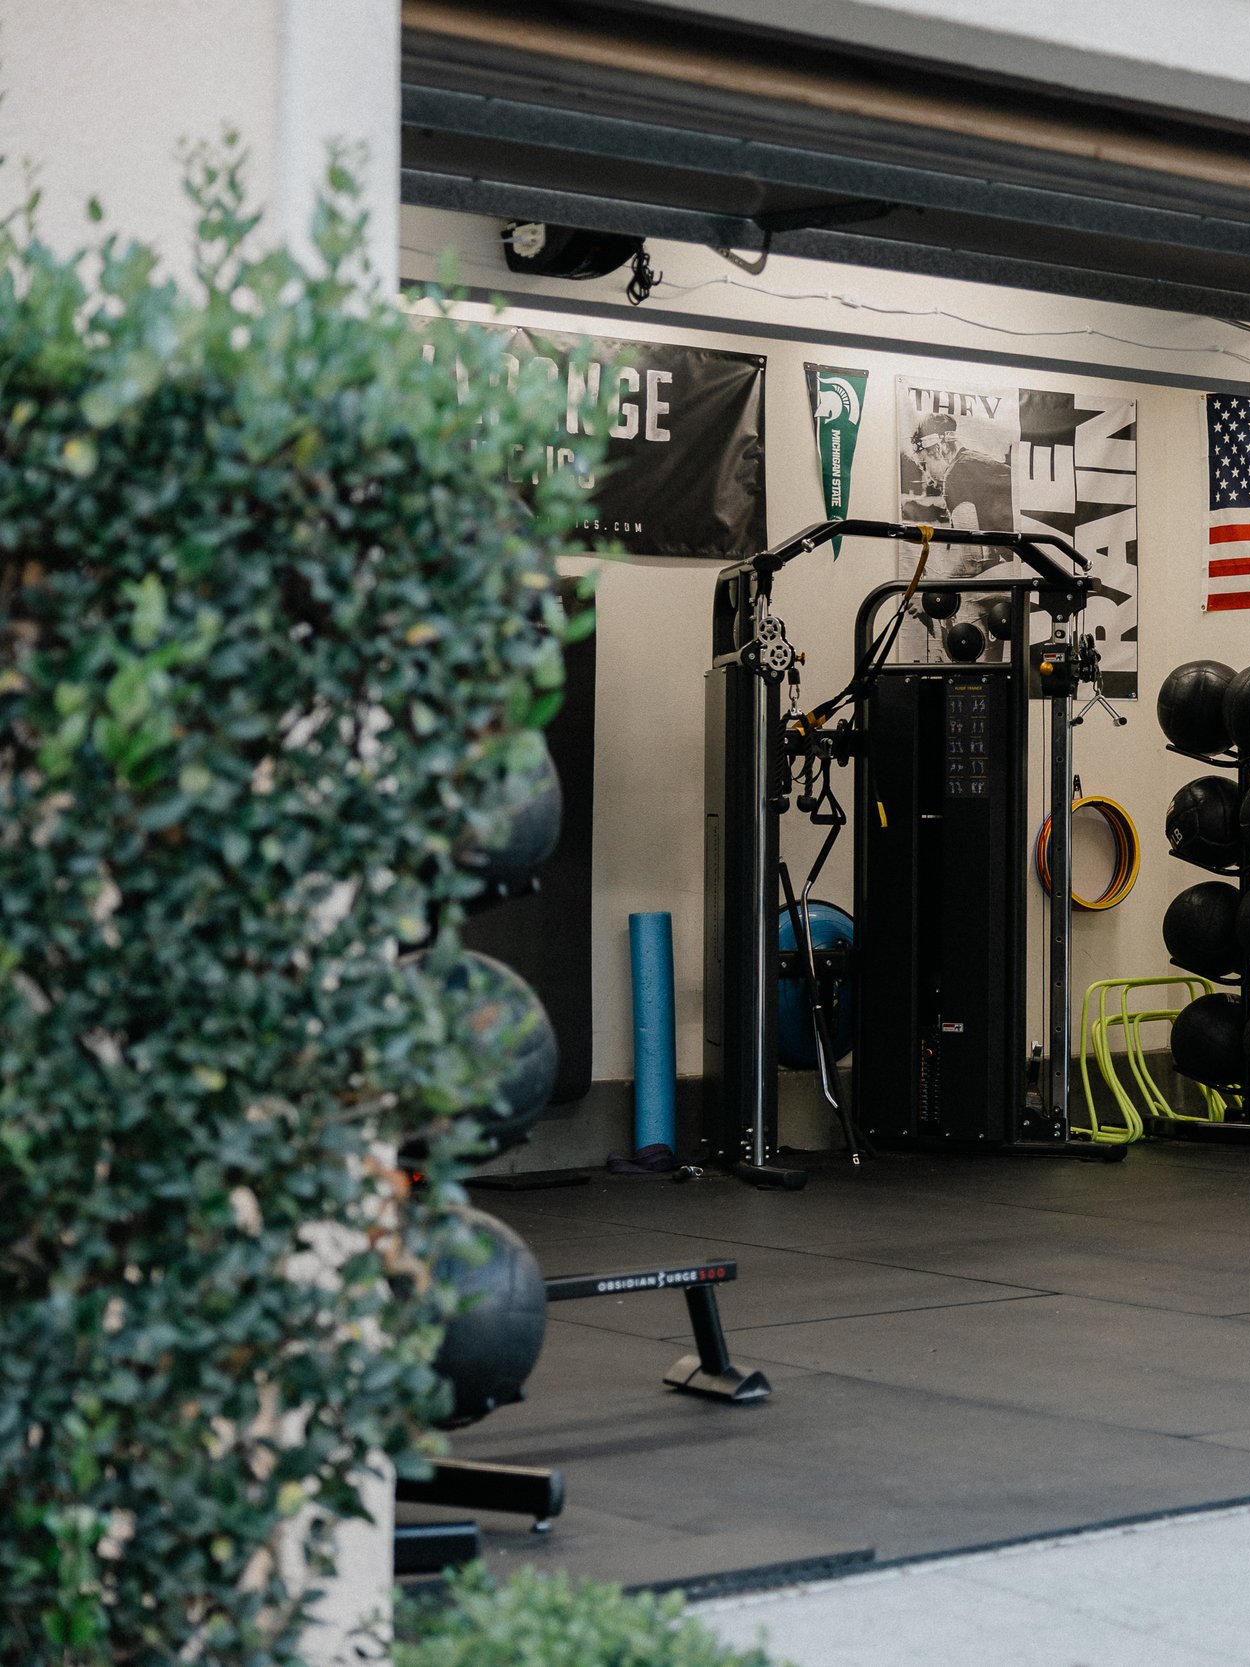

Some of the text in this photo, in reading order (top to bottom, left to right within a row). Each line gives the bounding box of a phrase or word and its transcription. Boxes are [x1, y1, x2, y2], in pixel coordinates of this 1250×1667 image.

[831, 428, 842, 507] MICHIGAN STATE
[598, 1276, 656, 1292] OBSIDIAN
[699, 1267, 726, 1280] 500
